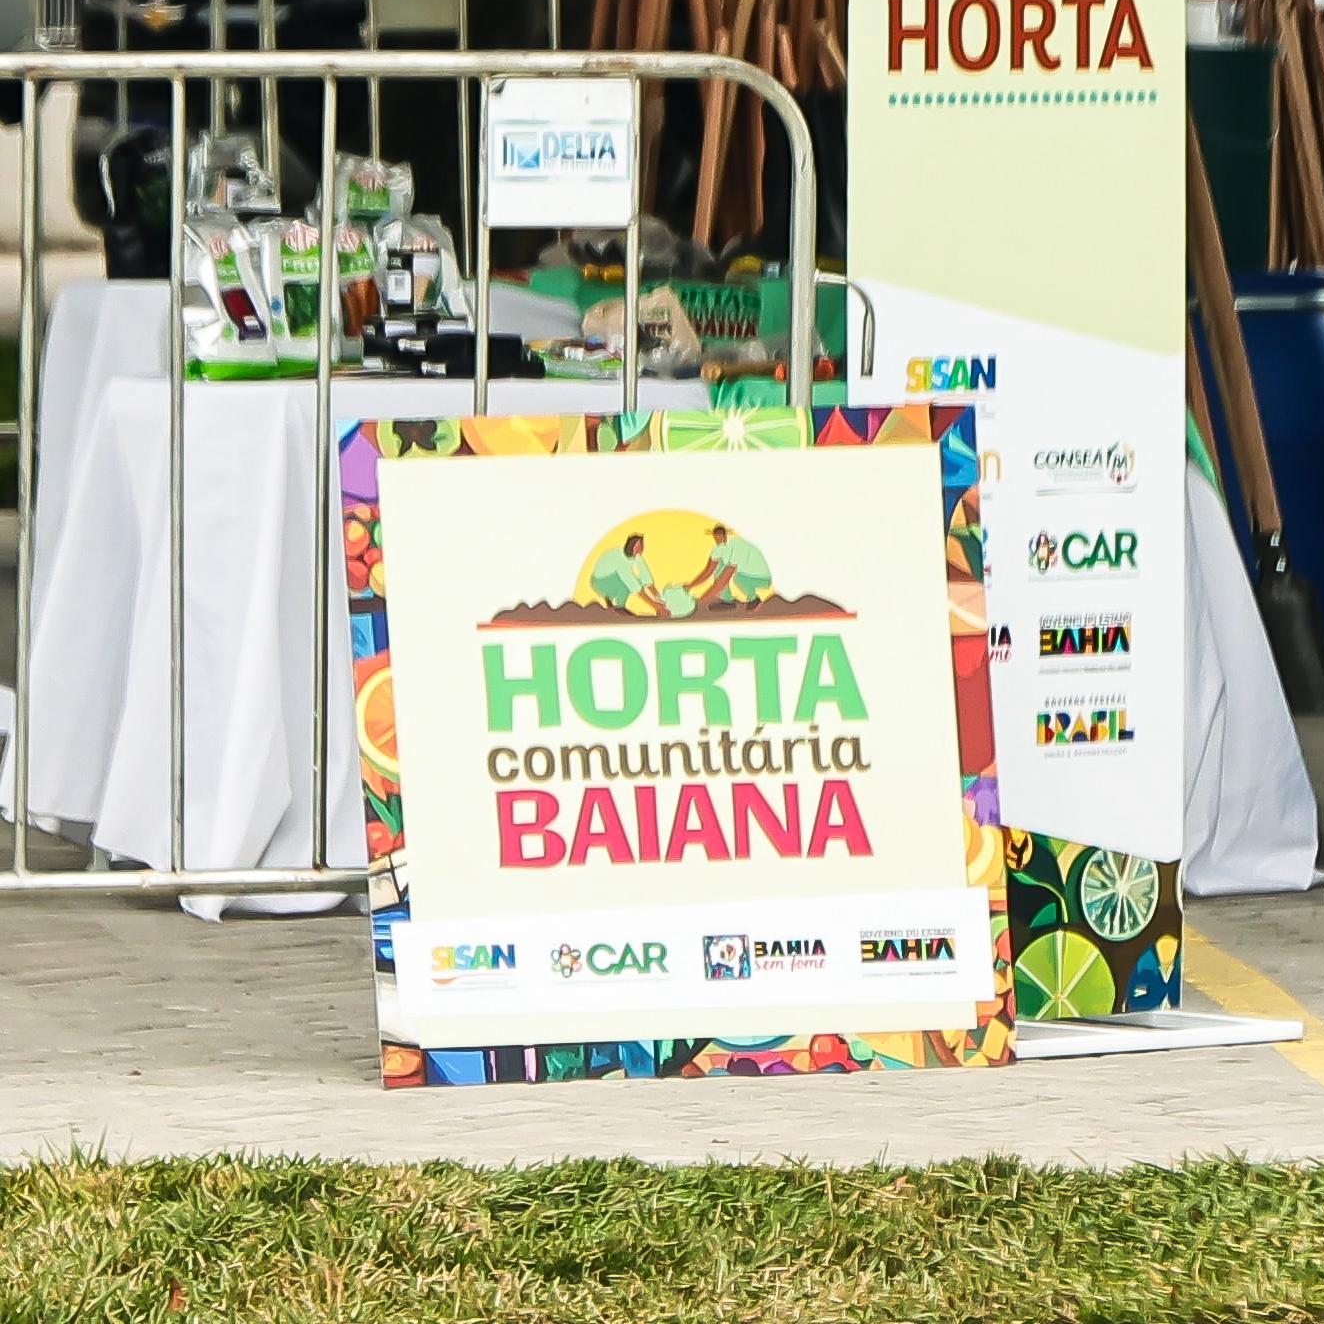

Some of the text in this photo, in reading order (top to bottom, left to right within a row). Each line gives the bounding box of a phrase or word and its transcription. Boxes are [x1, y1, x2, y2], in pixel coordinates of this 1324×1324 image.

[542, 132, 616, 160] DELTA
[906, 355, 998, 393] SISAN
[1061, 528, 1138, 571] CAR
[990, 623, 1012, 646] IA
[1039, 626, 1131, 657] BAHIA
[482, 632, 870, 734] HORTA
[1037, 707, 1135, 746] BRASIL
[487, 721, 872, 784] comunitária
[497, 778, 874, 870] BAIANA
[431, 943, 517, 972] SISAN
[586, 942, 670, 976] CAR
[754, 939, 827, 958] BAHIA
[860, 937, 955, 963] BAHIA
